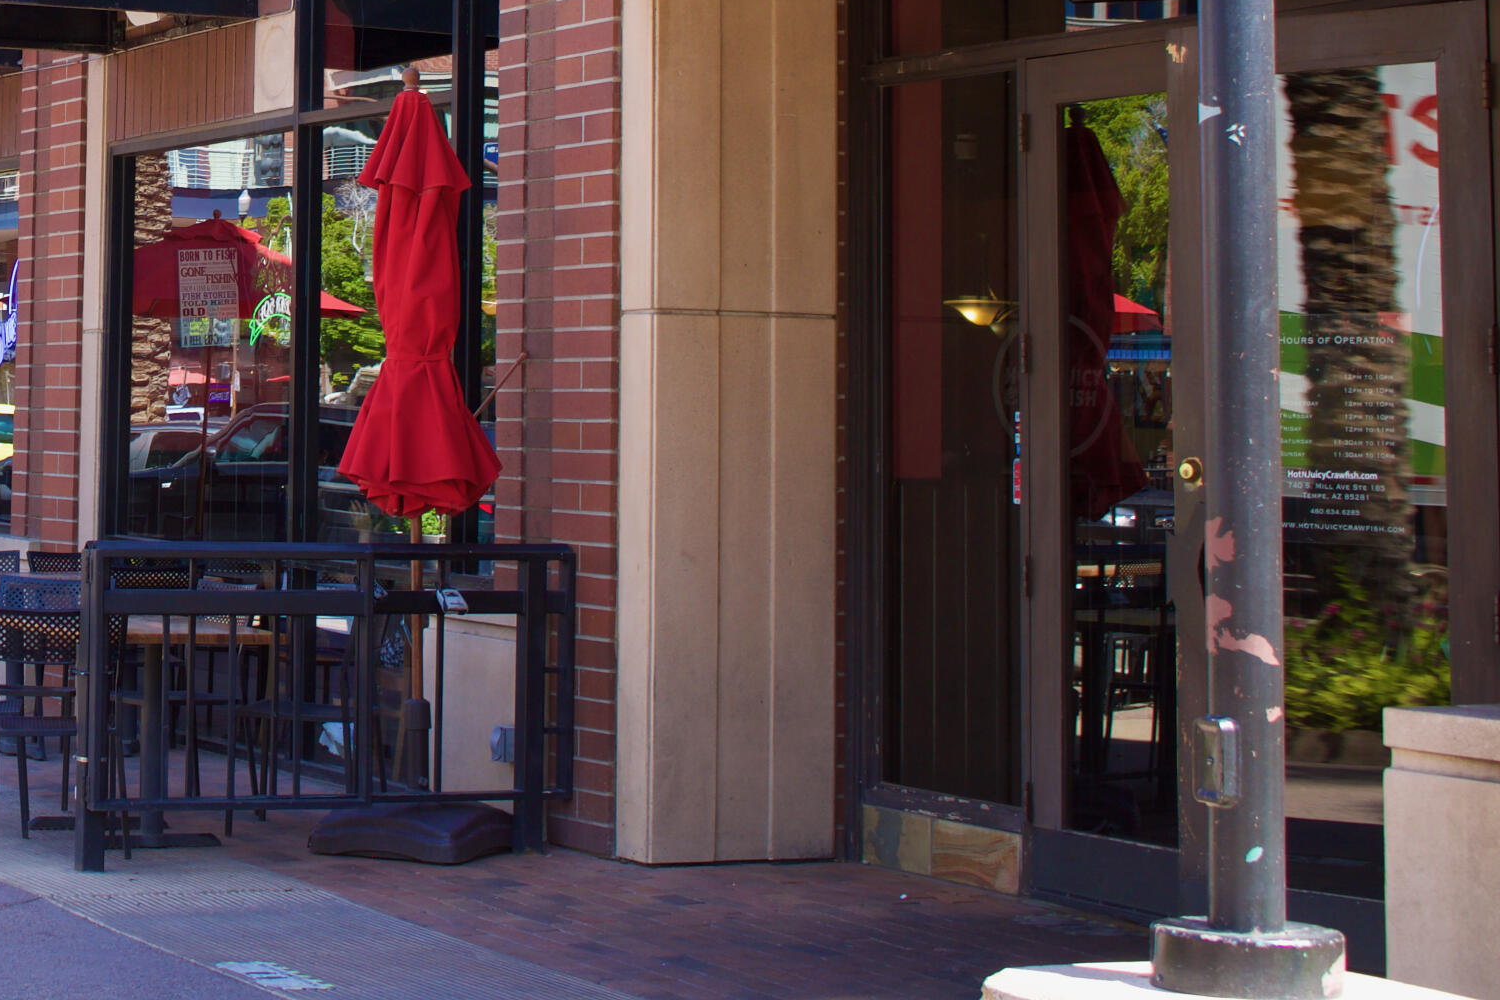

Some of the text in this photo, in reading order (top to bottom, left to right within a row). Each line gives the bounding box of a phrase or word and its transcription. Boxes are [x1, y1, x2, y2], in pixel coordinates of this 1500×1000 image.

[180, 250, 200, 262] BORN
[203, 250, 213, 261] TO
[182, 307, 205, 317] OLD
[1334, 335, 1394, 345] OPERATION
[1287, 469, 1378, 480] HotNJuicyCrawfish.com
[1281, 522, 1405, 533] WW.HOTNJUICYCRAWFISH.COM
